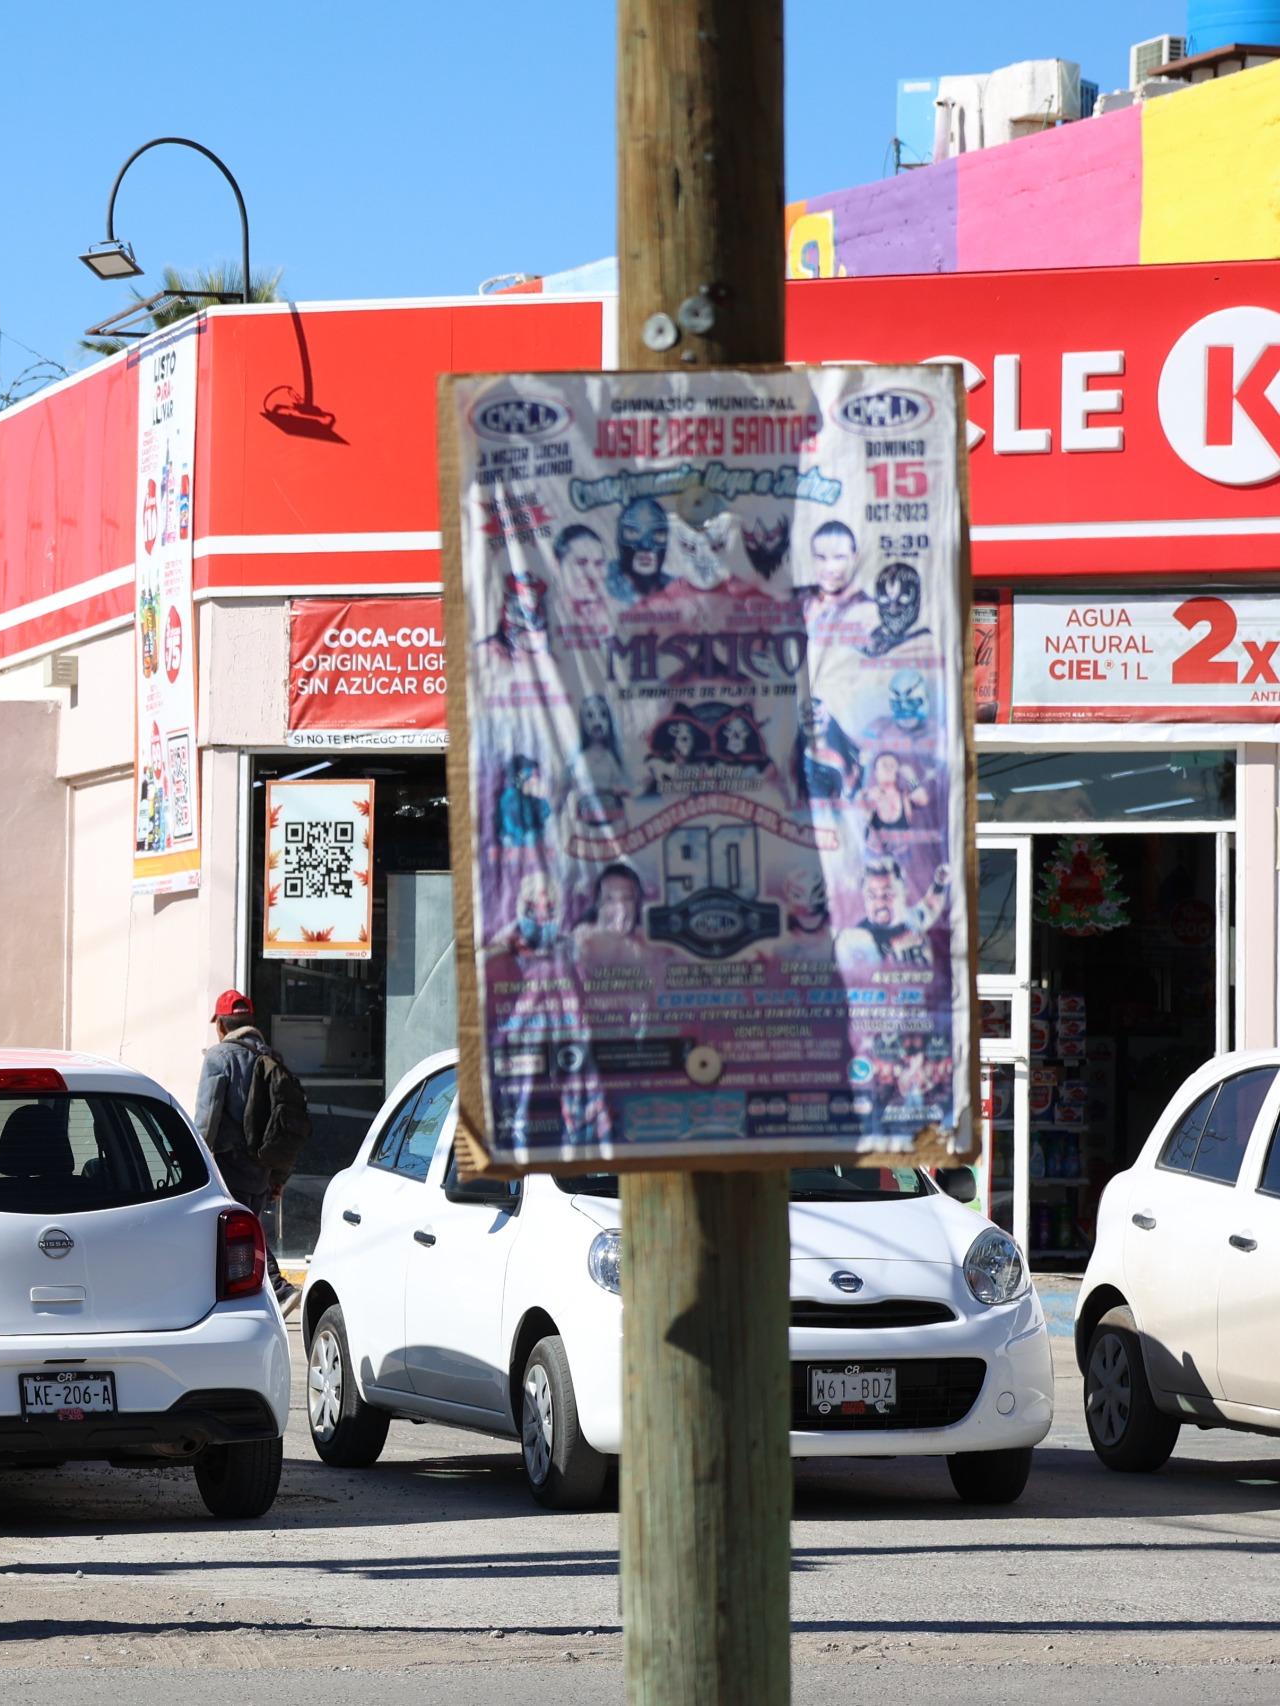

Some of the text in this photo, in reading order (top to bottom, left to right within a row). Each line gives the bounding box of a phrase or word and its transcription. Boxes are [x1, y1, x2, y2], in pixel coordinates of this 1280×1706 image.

[866, 461, 928, 499] 15
[1066, 608, 1132, 627] AGUA
[1045, 636, 1154, 654] NATURAL
[302, 653, 447, 674] ORIGINAL, LIGH
[1121, 662, 1128, 680] 1
[1136, 662, 1148, 680] L
[297, 678, 328, 695] SIN
[334, 673, 417, 695] AZÚCAR
[1251, 691, 1280, 702] ANT
[294, 734, 304, 744] SI
[307, 735, 323, 744] NO
[326, 735, 340, 745] TE
[419, 733, 450, 743] TICKE
[39, 1240, 73, 1248] NISSAN
[24, 1384, 111, 1406] LKE-206-A
